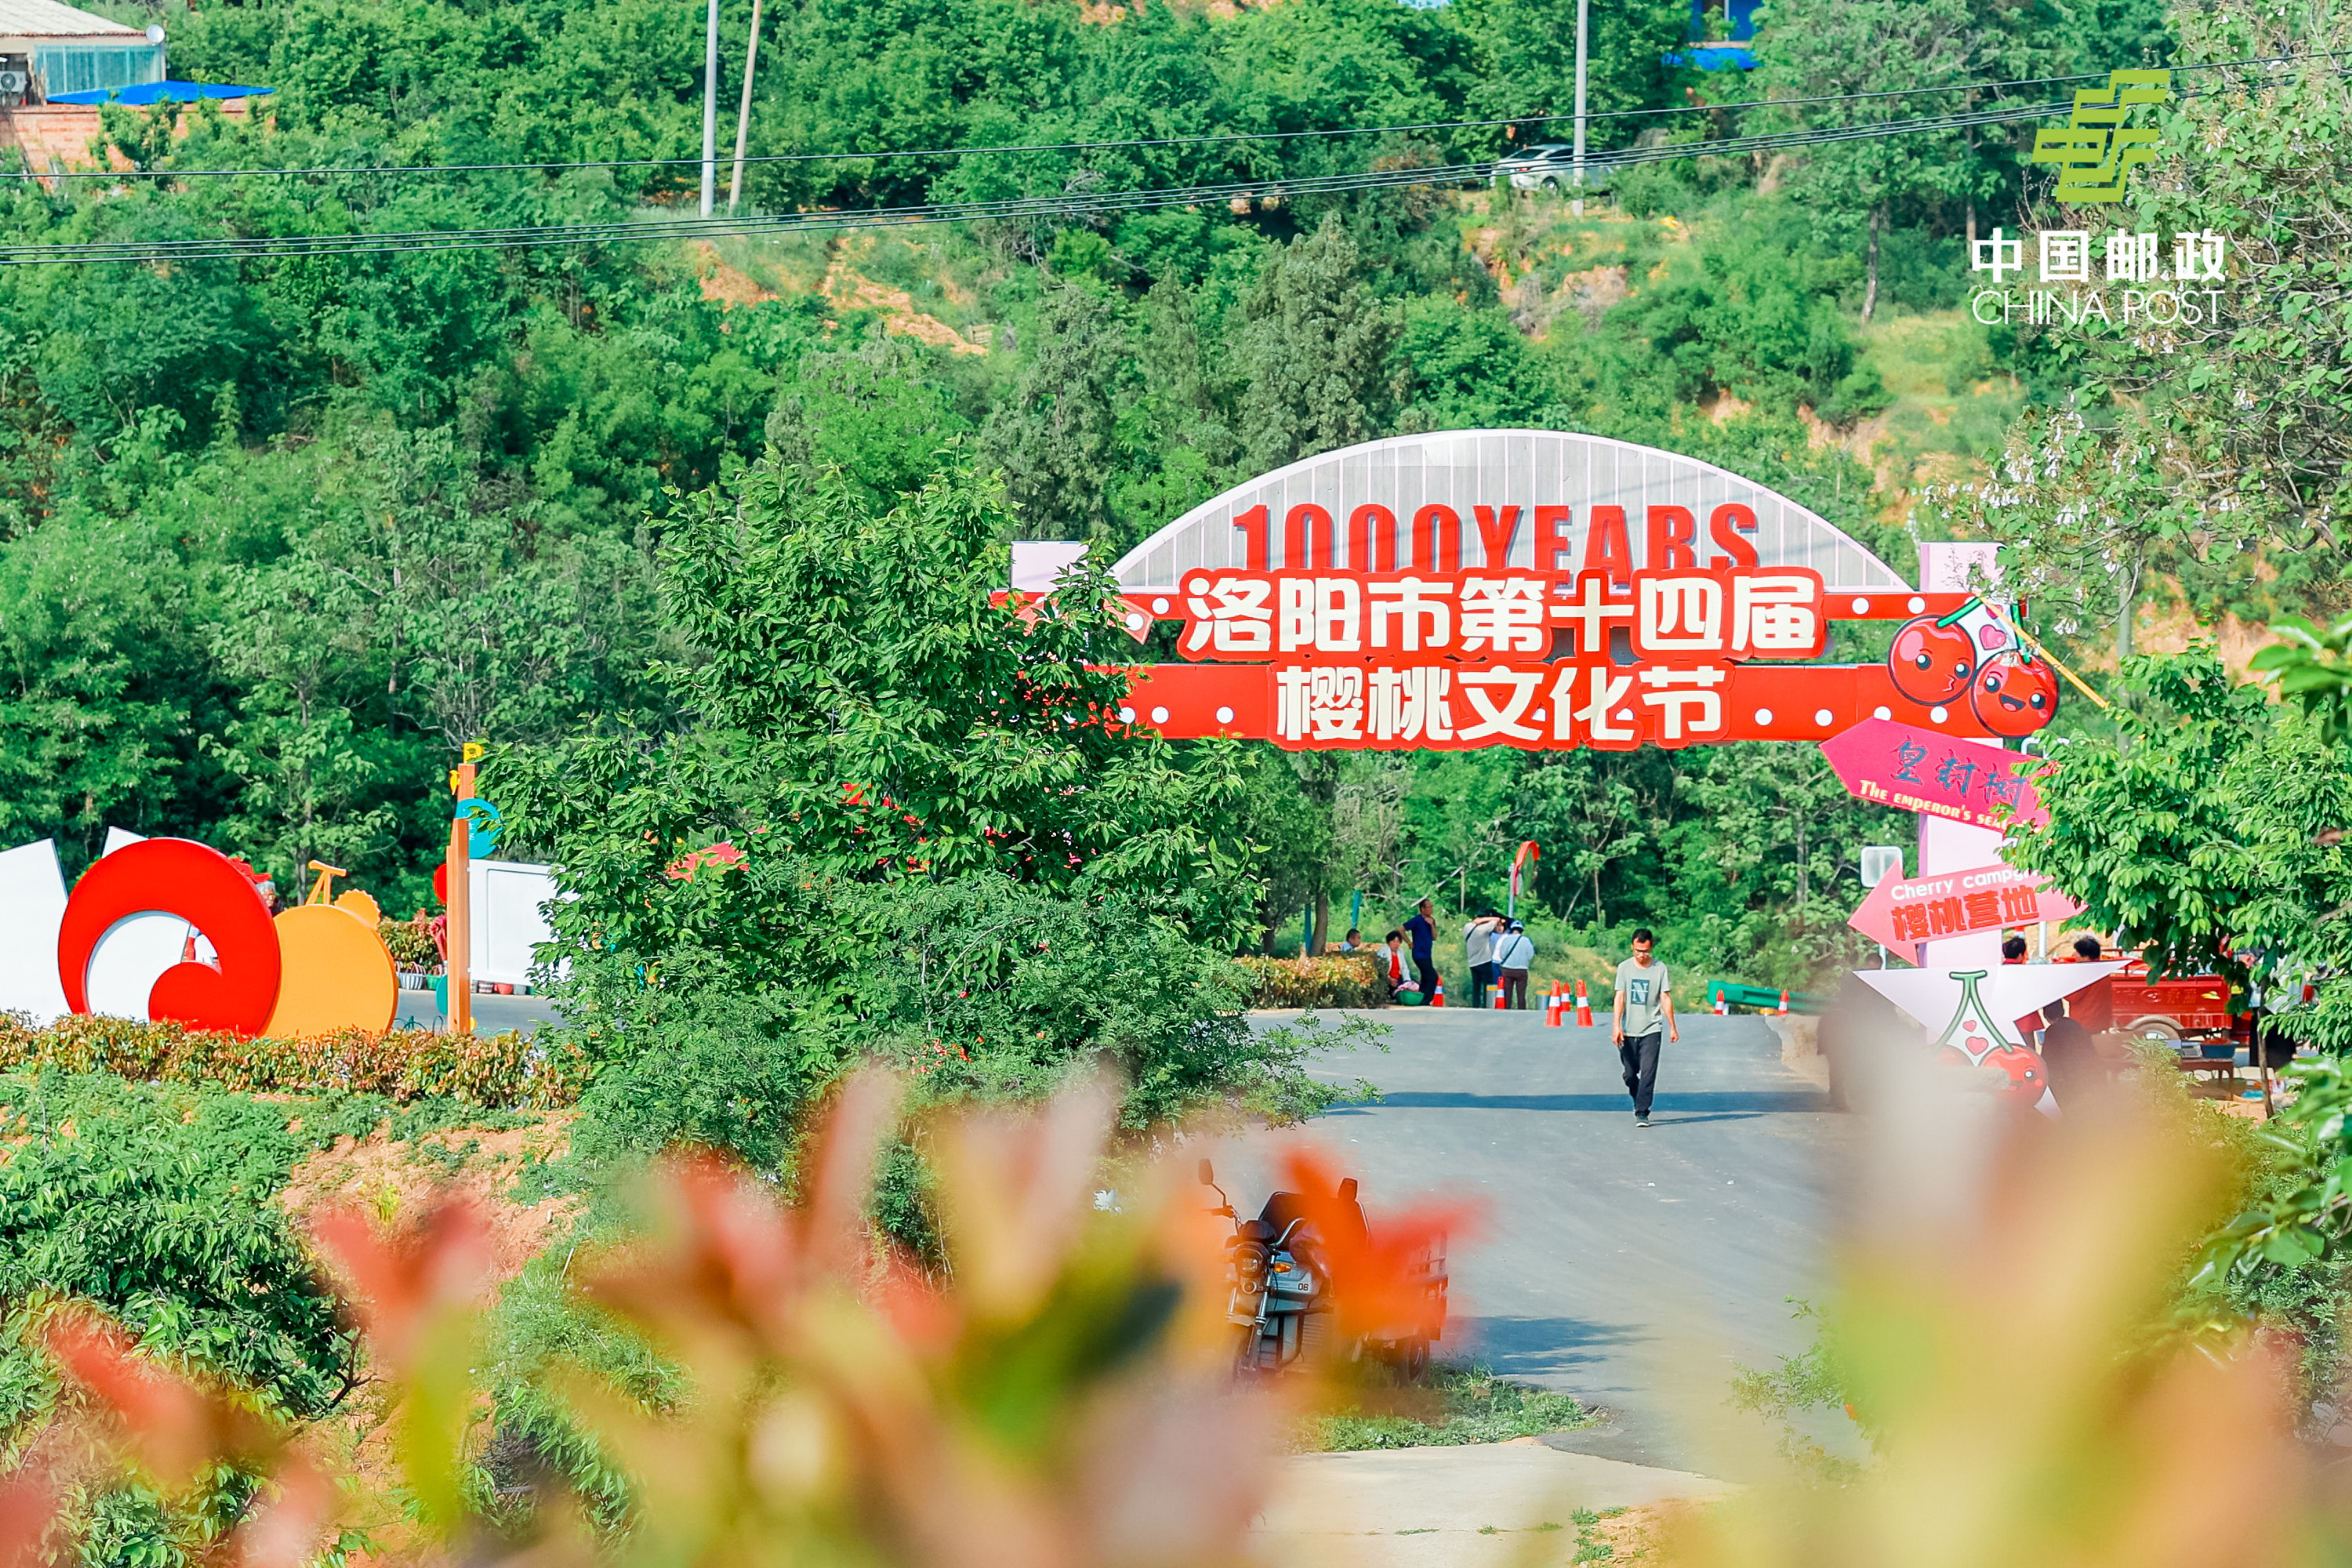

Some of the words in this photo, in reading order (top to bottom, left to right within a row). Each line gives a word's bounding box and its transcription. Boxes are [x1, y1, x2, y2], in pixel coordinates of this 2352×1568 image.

[1185, 575, 1818, 652] 洛阳市第十四届
[1276, 665, 1724, 742] 樱桃文化节
[1890, 878, 1954, 901] Cherry
[1890, 884, 2039, 941] 樱桃营地
[1298, 1283, 1309, 1291] 06
